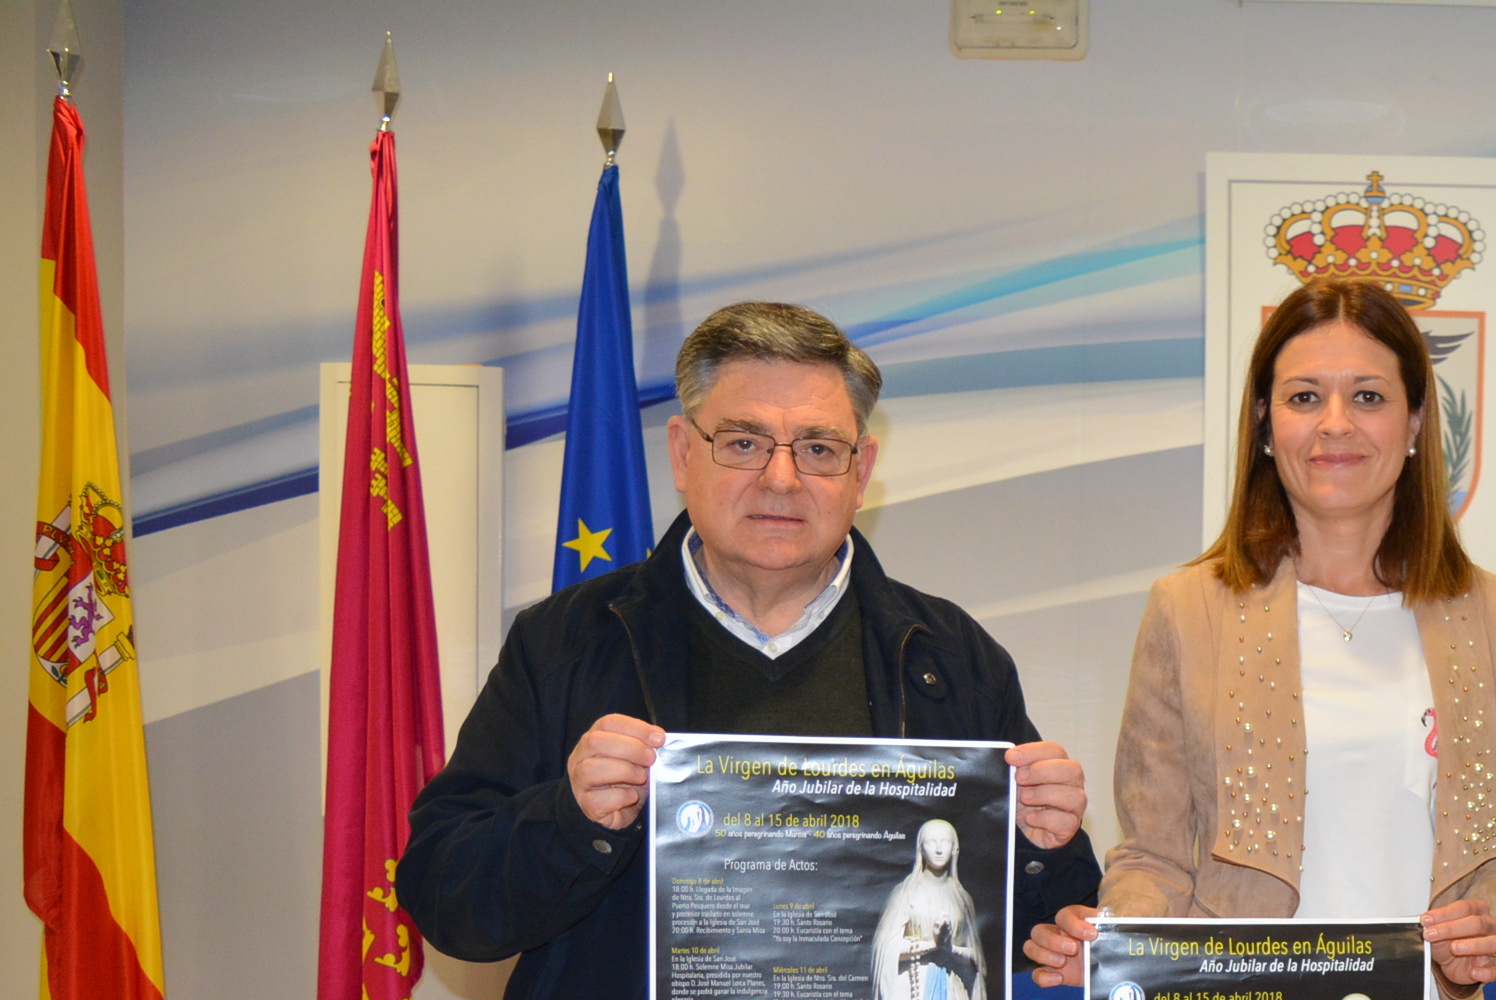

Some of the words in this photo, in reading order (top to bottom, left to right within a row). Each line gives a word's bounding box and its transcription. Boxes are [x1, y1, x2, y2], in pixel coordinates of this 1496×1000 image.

[697, 755, 713, 773] La
[718, 755, 771, 780] Virgen
[777, 756, 797, 775] de
[803, 757, 866, 776] Lourdes
[871, 763, 890, 777] en
[895, 755, 954, 783] Águilas
[771, 778, 796, 792] Año
[799, 779, 844, 794] Jubilar
[845, 781, 861, 794] de
[864, 781, 875, 794] la
[879, 781, 956, 799] Hospitalidad
[723, 812, 740, 825] del
[744, 813, 751, 825] 8
[754, 813, 764, 826] al
[768, 813, 782, 826] 15
[785, 813, 799, 826] de
[802, 813, 827, 827] abril
[829, 815, 859, 827] 2018
[724, 858, 770, 873] Programa
[774, 858, 786, 870] de
[789, 859, 817, 870] Actos:
[1128, 938, 1144, 955] La
[1149, 937, 1198, 960] Virgen
[1204, 937, 1222, 955] de
[1229, 937, 1288, 954] Lourdes
[1293, 941, 1311, 954] en
[1315, 933, 1372, 958] Águilas
[1199, 959, 1222, 972] Año
[1225, 959, 1267, 972] Jubilar
[1269, 959, 1283, 972] de
[1286, 959, 1297, 971] la
[1301, 958, 1374, 974] Hospitalidad
